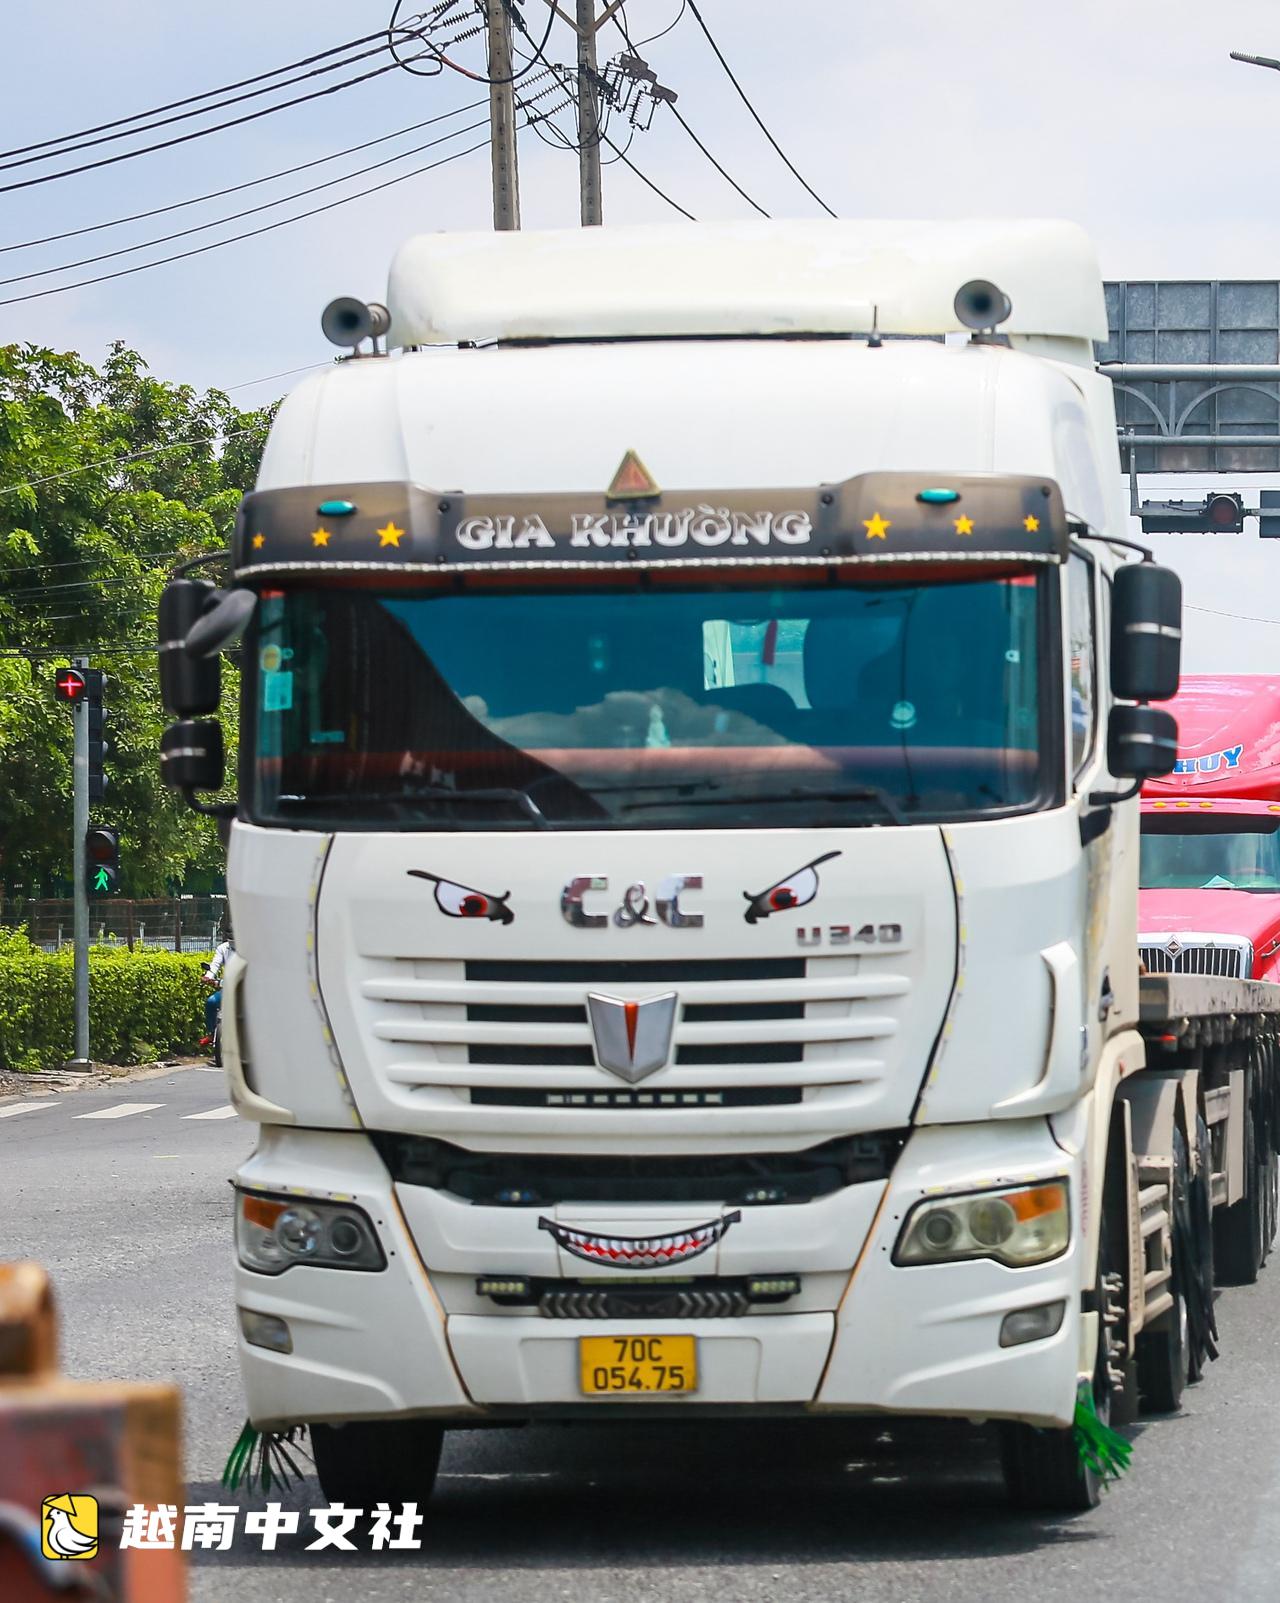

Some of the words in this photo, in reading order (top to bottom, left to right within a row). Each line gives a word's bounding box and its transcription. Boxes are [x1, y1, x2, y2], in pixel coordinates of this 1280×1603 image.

[455, 515, 555, 549] GIA
[570, 504, 813, 548] KHƯỜNG
[1172, 743, 1244, 775] HUY
[561, 873, 705, 929] C&C
[796, 926, 821, 947] U
[829, 923, 903, 945] 340
[613, 1338, 663, 1363] 70C
[593, 1366, 685, 1391] 054.75
